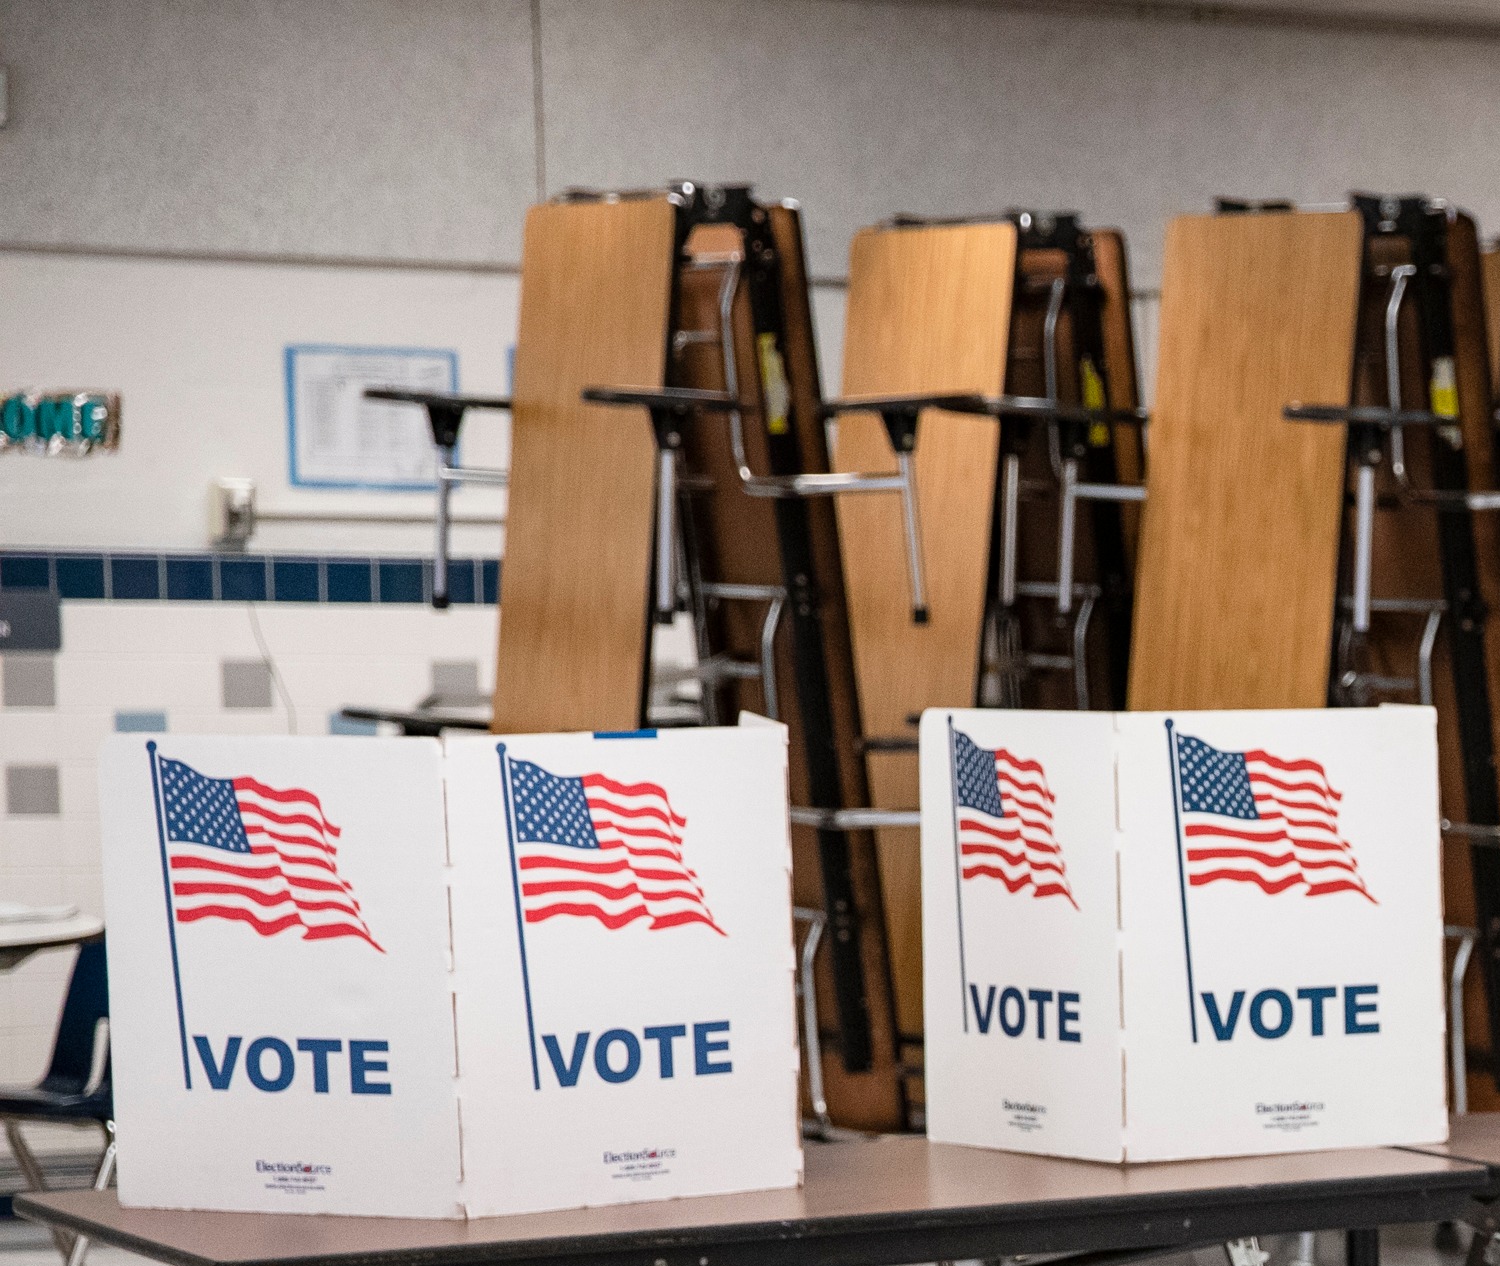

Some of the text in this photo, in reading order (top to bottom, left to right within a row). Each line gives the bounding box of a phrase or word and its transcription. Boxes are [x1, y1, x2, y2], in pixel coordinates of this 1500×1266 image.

[969, 983, 1081, 1042] VOTE
[1201, 984, 1381, 1041] VOTE
[193, 1034, 392, 1096] VOTE
[542, 1020, 734, 1088] VOTE
